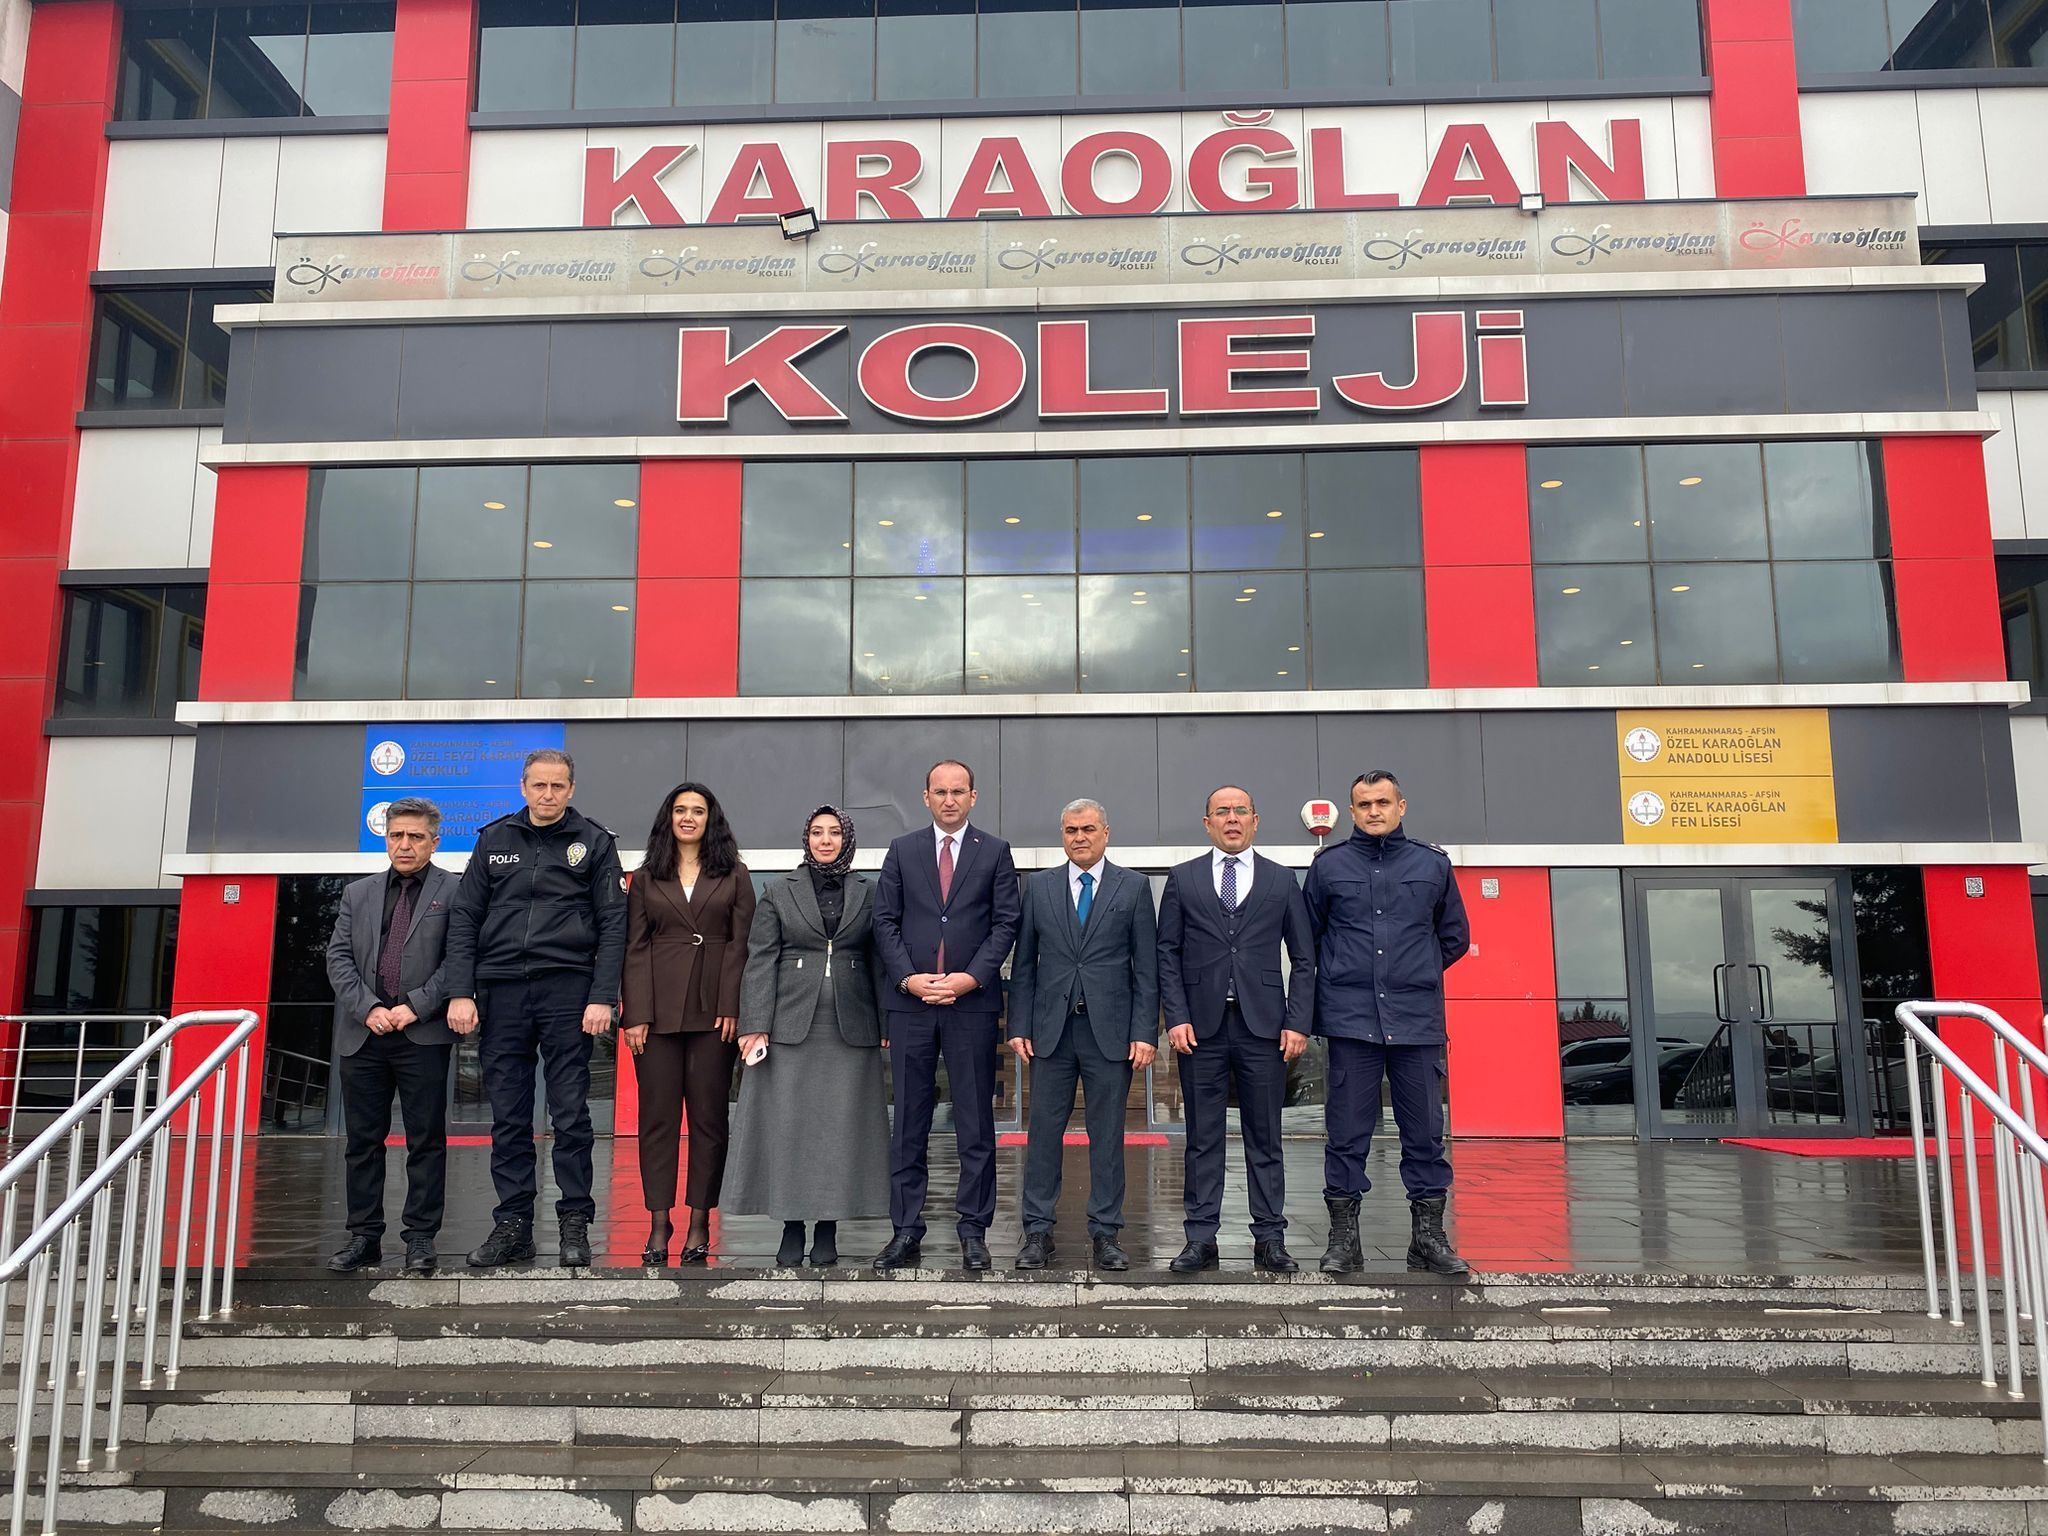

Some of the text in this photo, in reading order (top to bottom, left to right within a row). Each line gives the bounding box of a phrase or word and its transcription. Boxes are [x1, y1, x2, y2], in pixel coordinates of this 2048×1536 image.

[583, 109, 1645, 226] KARAOĞLAN
[1666, 728, 1743, 736] KAHRAMANMARAŞ
[1666, 736, 1781, 749] ÖZEL KARAOĞLAN
[411, 749, 440, 761] ÖZEL
[480, 748, 531, 760] KARAOĞ
[1667, 750, 1773, 763] ANADOLU LİSESİ
[1670, 791, 1747, 799] KAHRAMANMARAŞ
[1670, 799, 1786, 812] ÖZEL KARAOĞLAN
[1672, 814, 1741, 827] FEN LİSESİ
